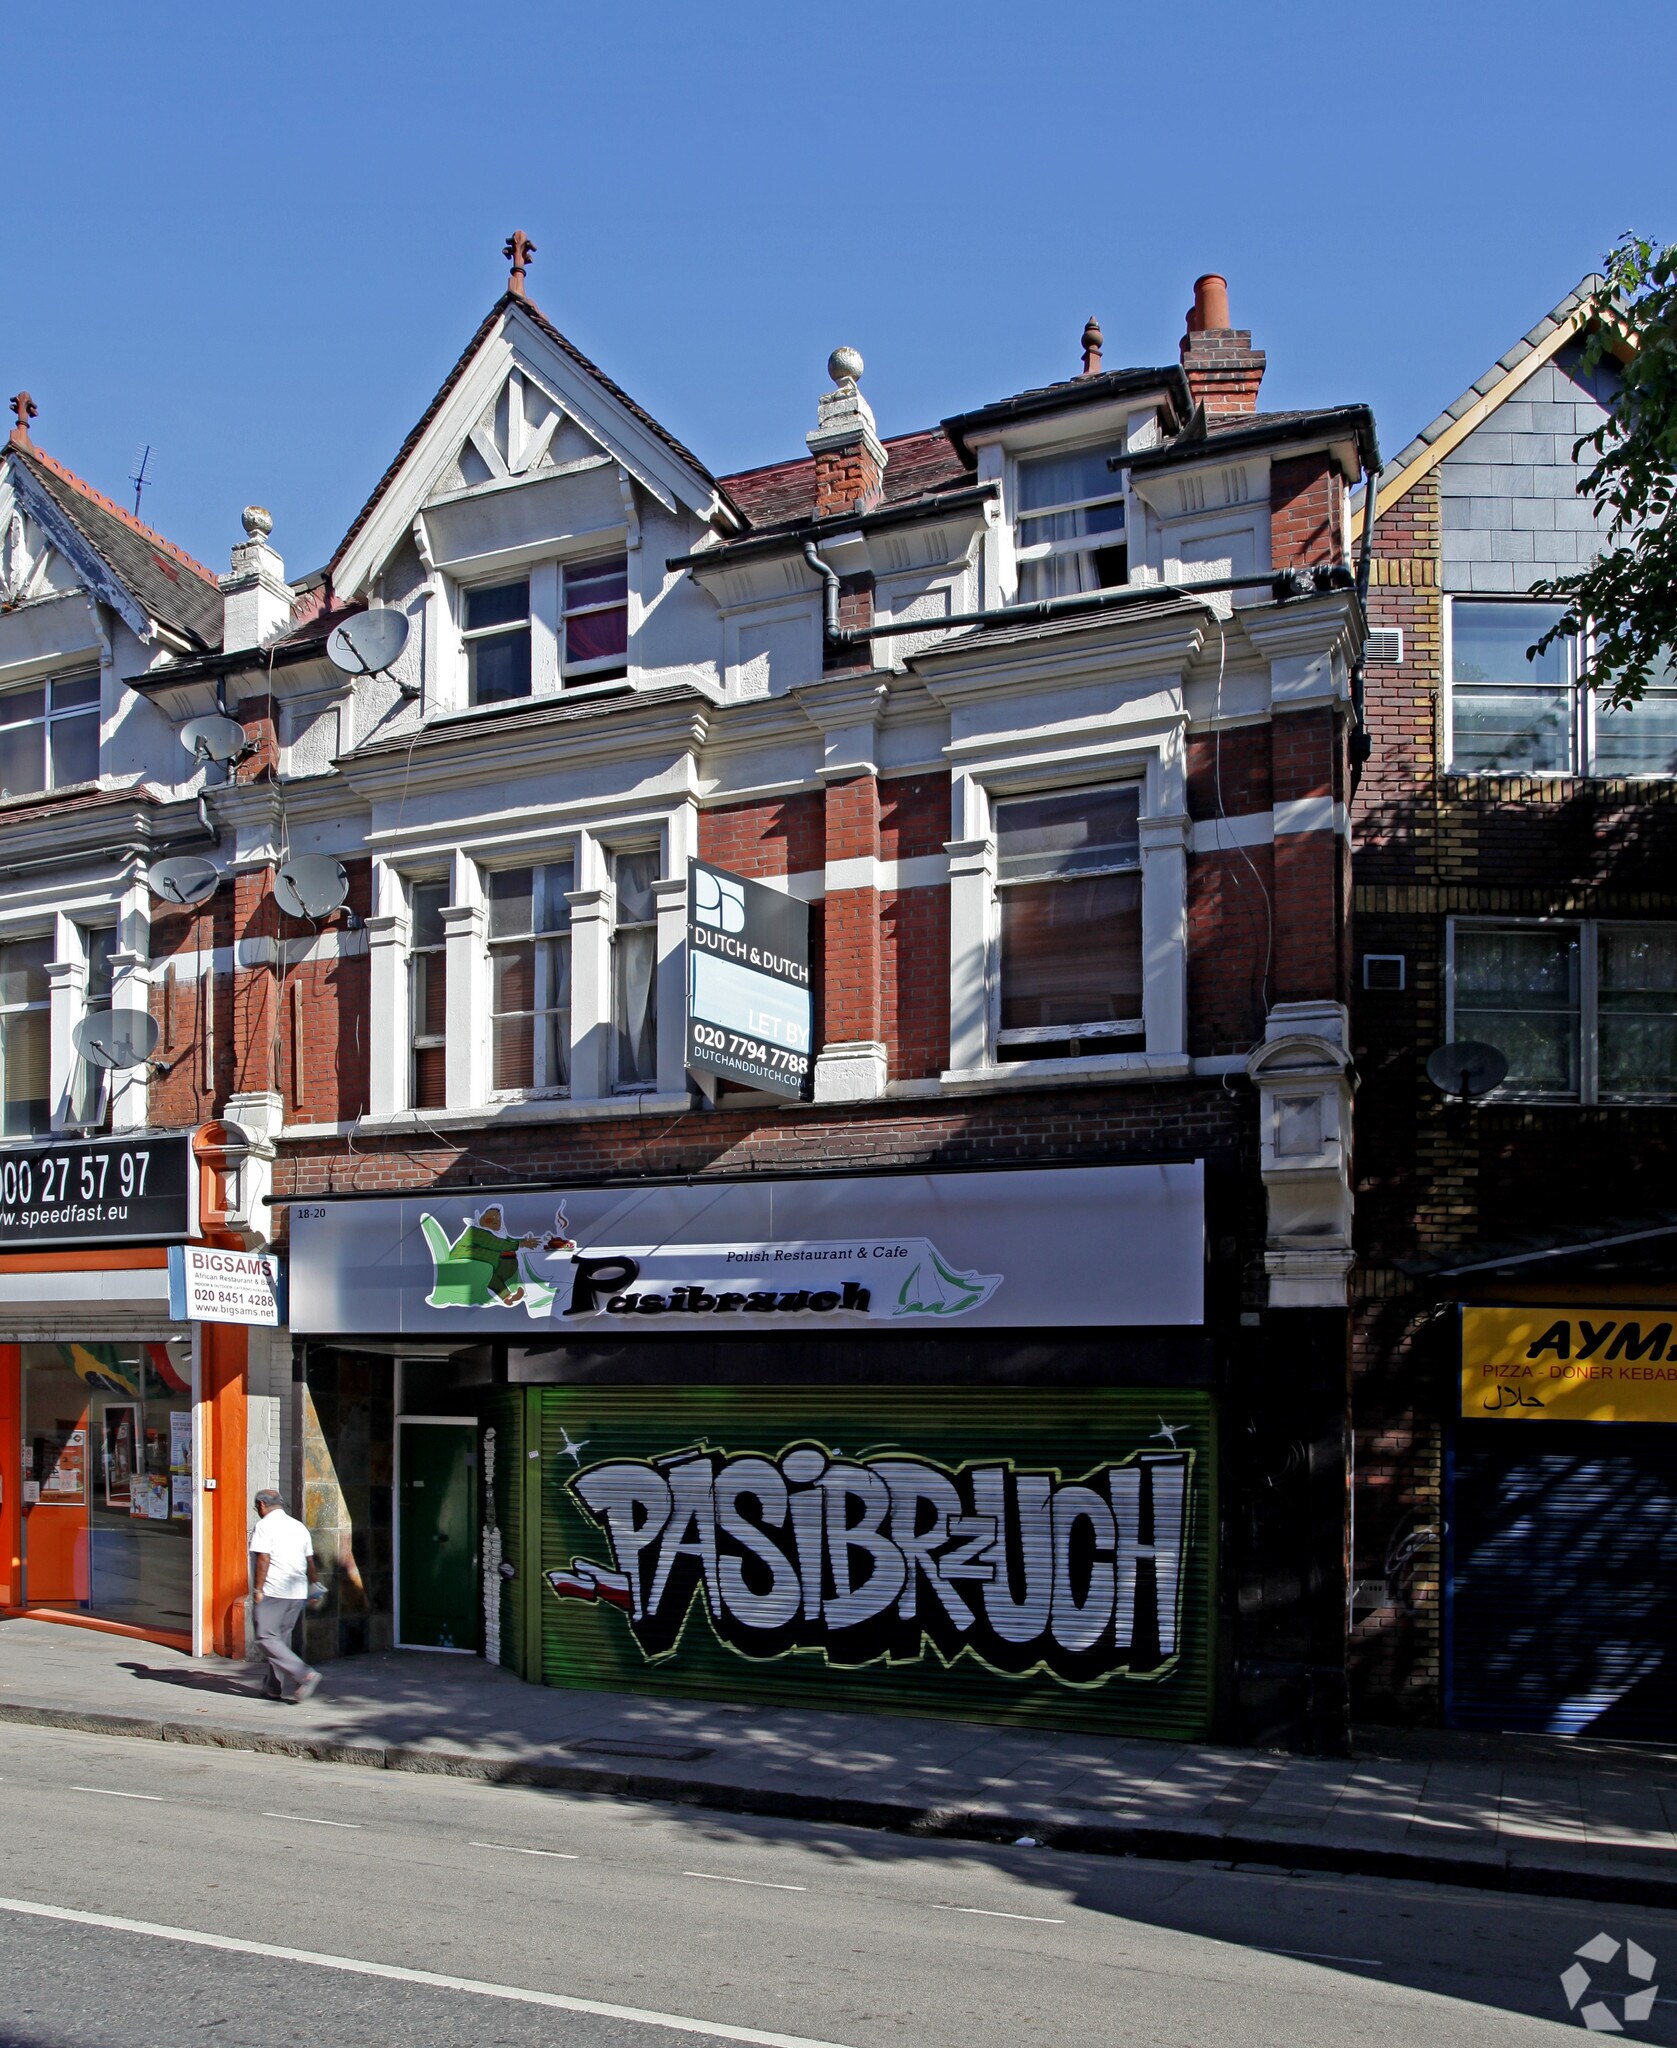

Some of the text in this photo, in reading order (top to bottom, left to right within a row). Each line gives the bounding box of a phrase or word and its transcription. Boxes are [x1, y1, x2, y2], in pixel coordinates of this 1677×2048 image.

[695, 927, 809, 984] DUTCH & DUTCH
[749, 1008, 810, 1047] LET BY
[694, 1024, 809, 1075] 020 7794 7788
[695, 1046, 806, 1088] DUTCHANDDUTCH.COM
[42, 1158, 70, 1202] 27
[81, 1155, 109, 1200] 57
[120, 1151, 150, 1198] 97
[298, 1209, 326, 1219] 18-20
[193, 1253, 271, 1276] BIGSAMS
[726, 1246, 908, 1262] Polish Restaurant & Cafe
[220, 1275, 252, 1284] Restaurant
[194, 1288, 274, 1307] 020 8451 4288
[196, 1304, 274, 1317] www.bigsams.net
[1483, 1364, 1533, 1378] PIZZA
[1550, 1366, 1613, 1380] DONER
[1619, 1367, 1677, 1381] KEBAB
[1483, 1384, 1545, 1410] حلال
